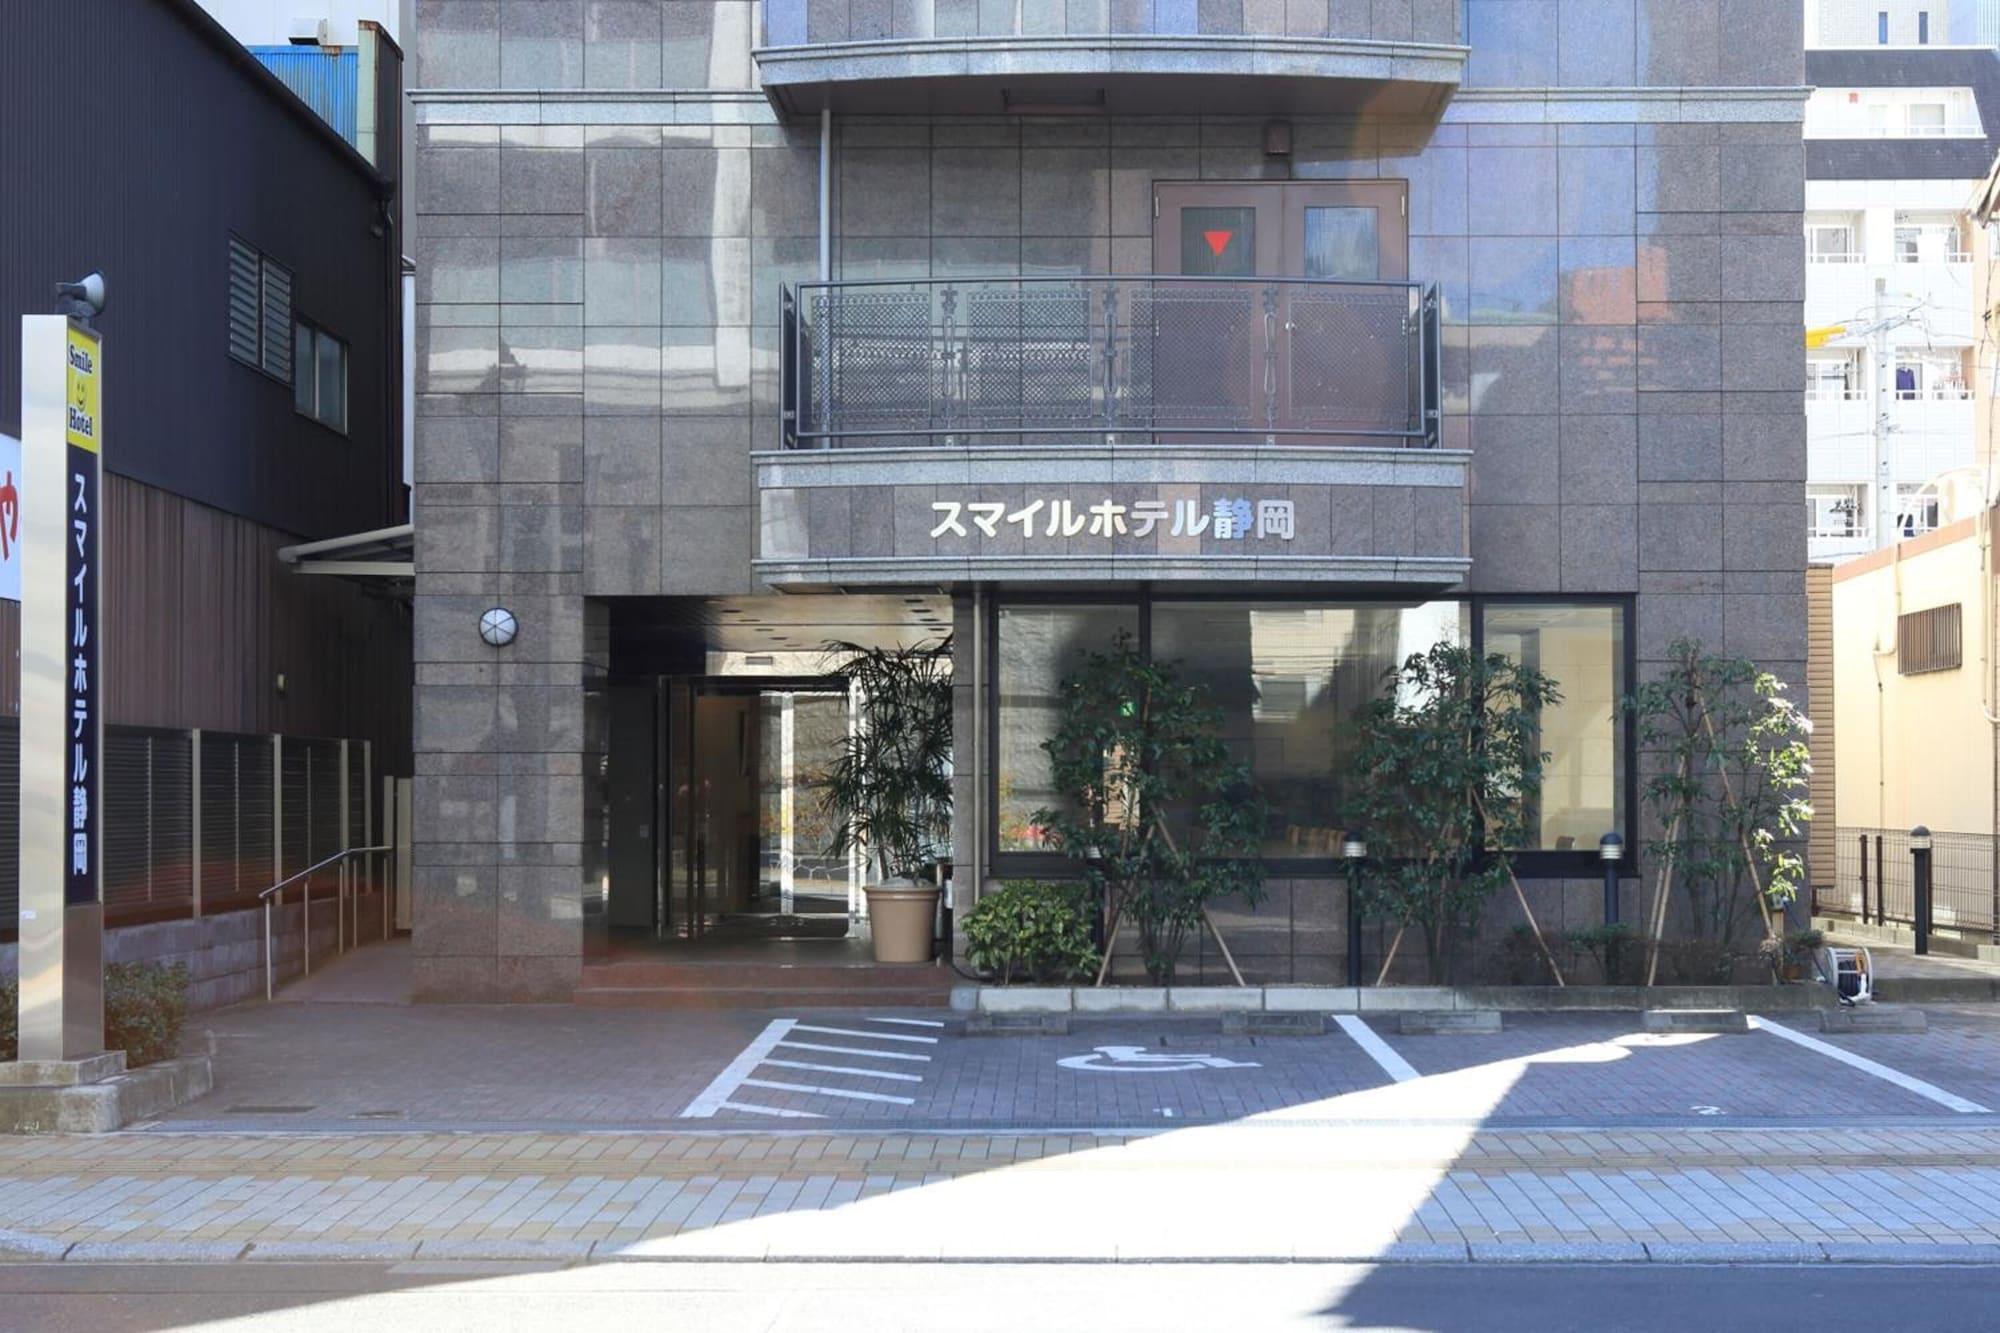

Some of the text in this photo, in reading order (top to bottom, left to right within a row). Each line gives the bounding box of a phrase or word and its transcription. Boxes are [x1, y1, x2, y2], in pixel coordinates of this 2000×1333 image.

[69, 344, 93, 374] Smile
[69, 407, 93, 437] Hotel
[930, 499, 1295, 539] スマイルホテル静岡
[73, 473, 88, 876] スマイルホテル静岡
